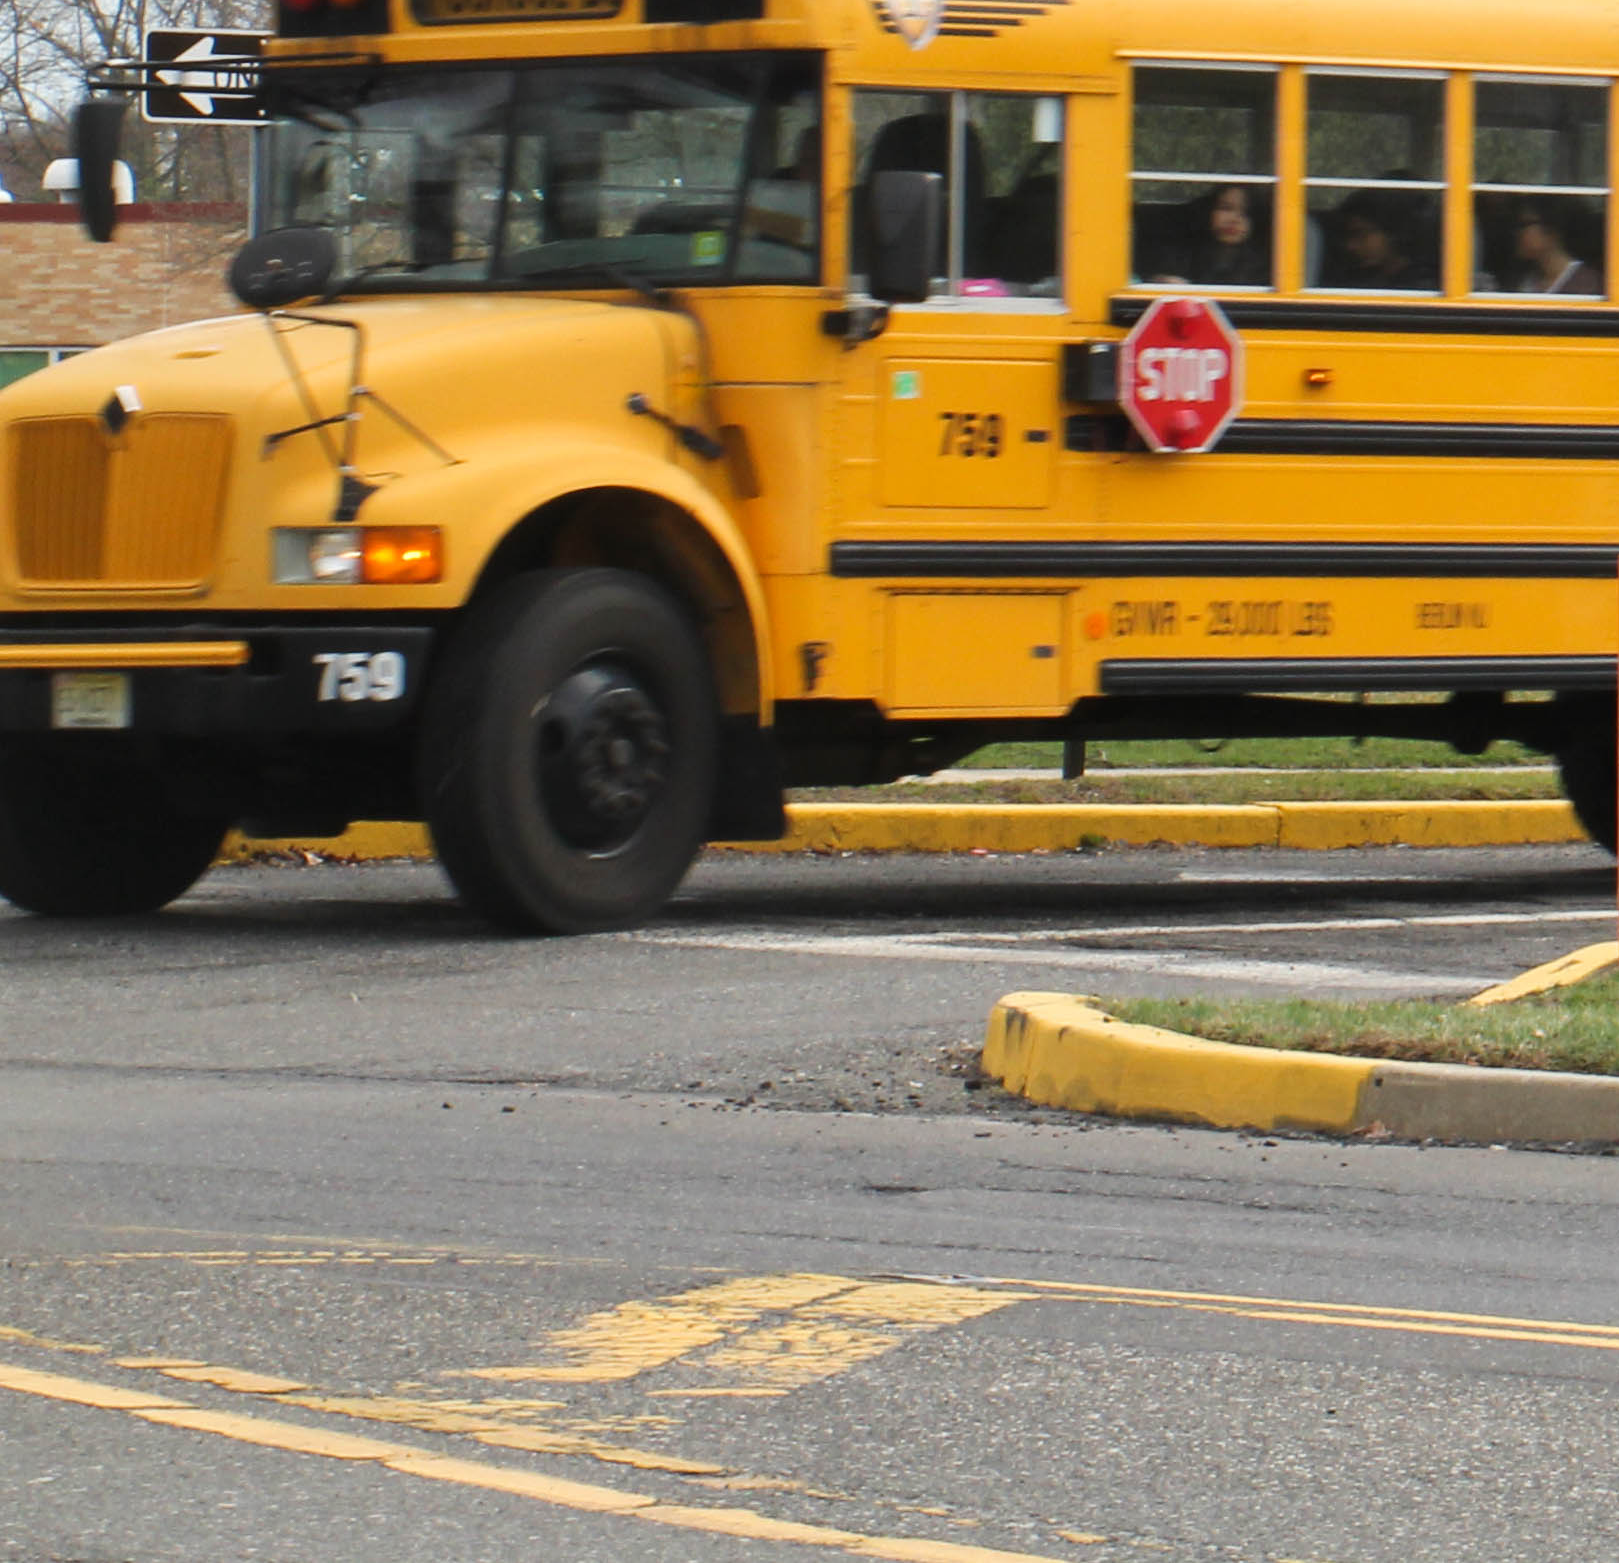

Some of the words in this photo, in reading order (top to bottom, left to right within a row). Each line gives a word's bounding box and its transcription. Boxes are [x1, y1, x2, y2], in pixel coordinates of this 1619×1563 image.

[1137, 347, 1229, 402] STOP
[938, 411, 1004, 459] 759
[312, 651, 405, 703] 759
